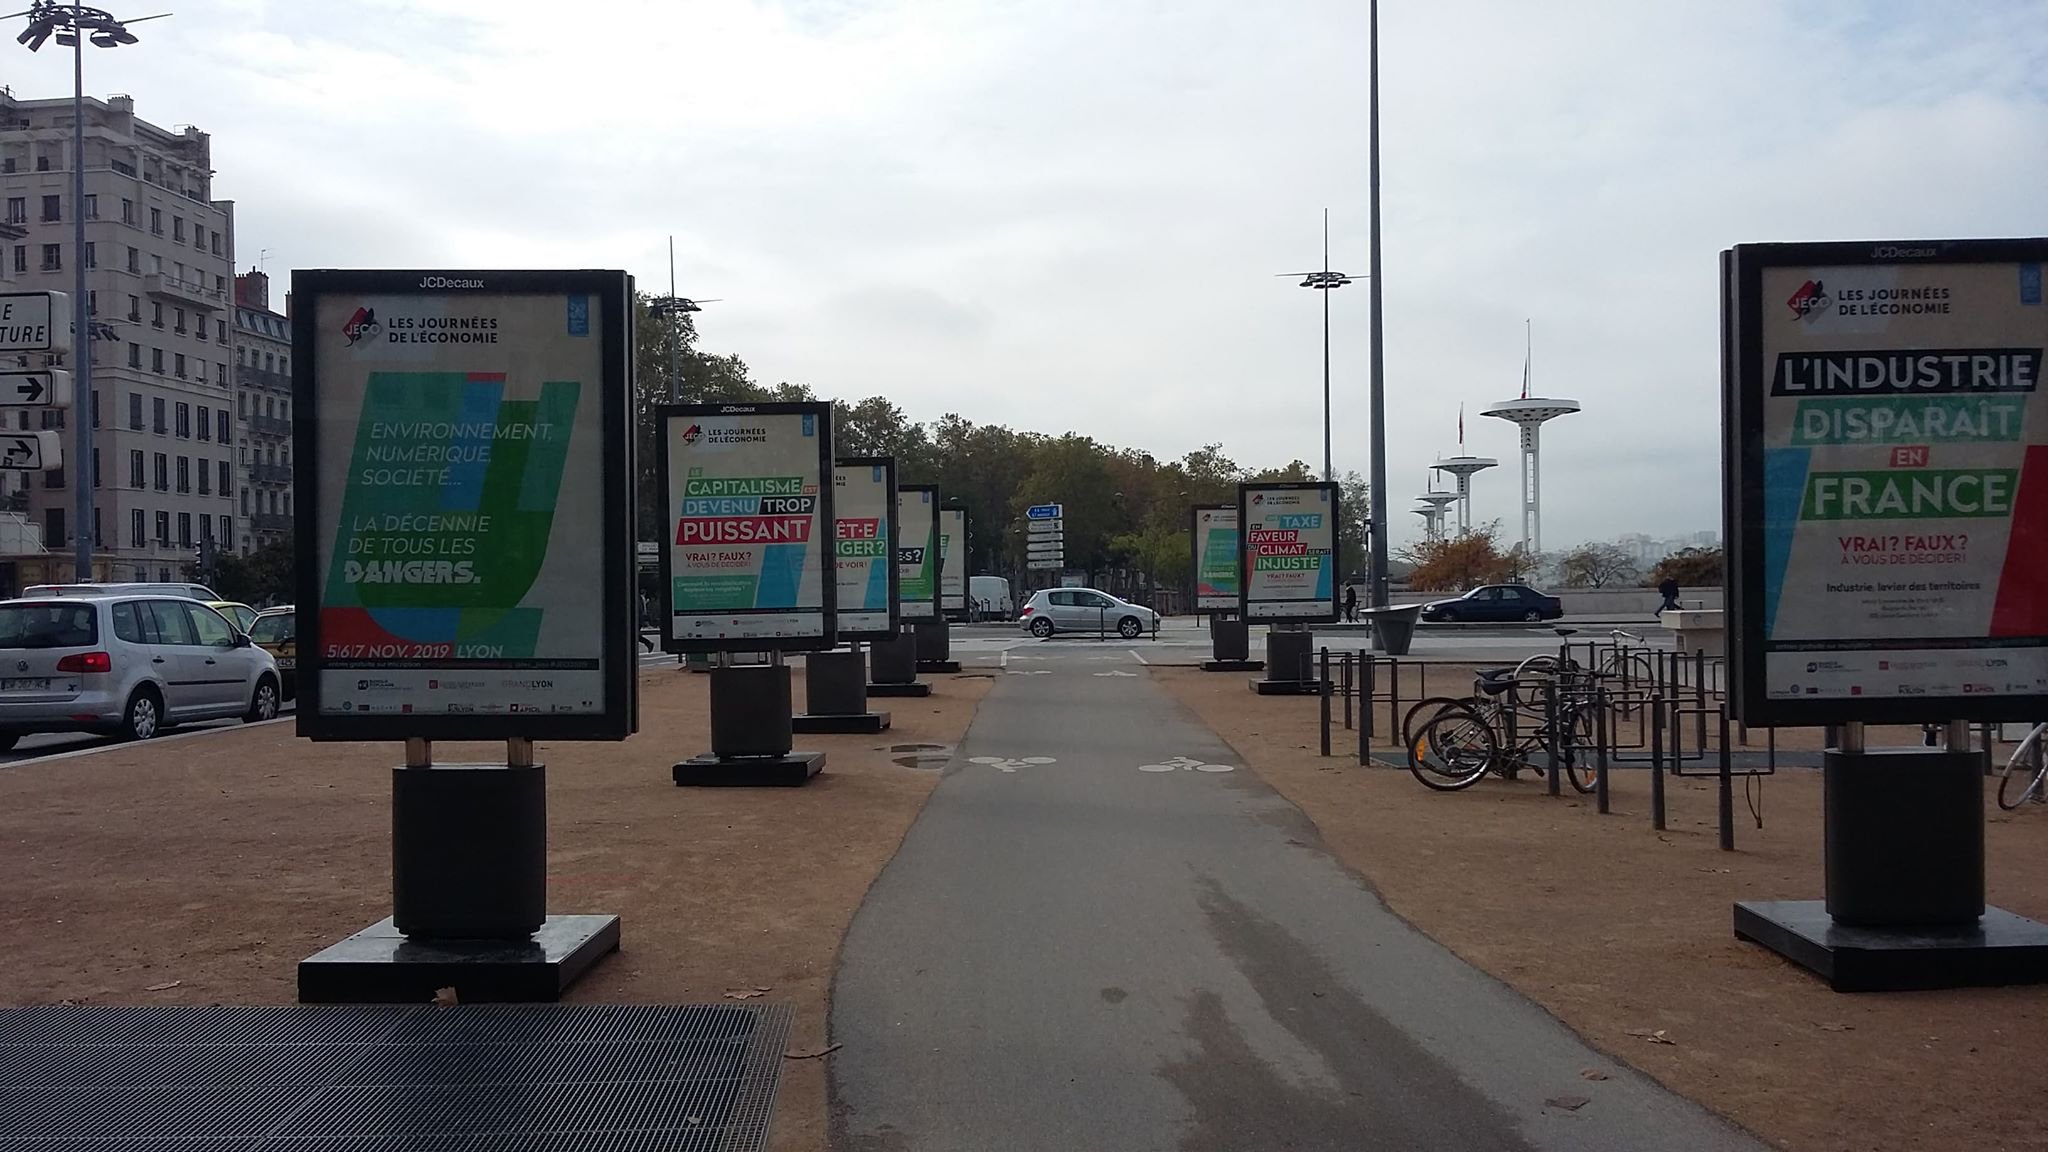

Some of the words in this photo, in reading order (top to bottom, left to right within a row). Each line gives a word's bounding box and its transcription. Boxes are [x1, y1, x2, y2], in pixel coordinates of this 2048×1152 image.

[1870, 246, 1937, 258] JCDecaux
[419, 277, 484, 289] JCDecaux
[1838, 290, 1863, 301] LES
[1868, 287, 1950, 300] JOURNÉES
[1839, 304, 1857, 316] DE
[388, 318, 414, 329] LES
[417, 316, 498, 329] JOURNÉES
[388, 333, 408, 344] DE
[411, 331, 498, 344] L'ÉCONOMIE
[1783, 354, 2033, 391] L'INDUSTRIE
[1803, 399, 2018, 440] DISPARAÎT
[370, 422, 553, 441] ENVIRONNEMENT,
[723, 427, 766, 435] JOURNÉES
[1896, 449, 1923, 466] EN
[687, 479, 800, 495] CAPITALISME
[1814, 475, 2008, 515] FRANCE
[686, 499, 755, 515] DEVENU
[763, 498, 811, 512] TROP
[352, 516, 377, 532] LA
[384, 514, 491, 532] DÉCENNIE
[1282, 515, 1319, 528] TAXE
[683, 520, 807, 542] PUISSANT
[1250, 531, 1296, 542] FAVEUR
[348, 538, 376, 554] DE
[381, 538, 434, 554] TOUS
[439, 538, 476, 554] LES
[1259, 544, 1305, 555] CLIMAT
[1838, 536, 1898, 552] VRAI?
[1258, 557, 1319, 570] INJUSTE
[1853, 554, 1887, 565] VOUS
[1890, 553, 1906, 564] DE
[344, 560, 481, 584] DANGERS.
[1877, 582, 1907, 591] levier
[1908, 581, 1927, 591] des
[1928, 580, 1981, 591] territoires
[368, 644, 409, 658] NOV.
[412, 644, 449, 658] 2019
[456, 645, 503, 658] LYON
